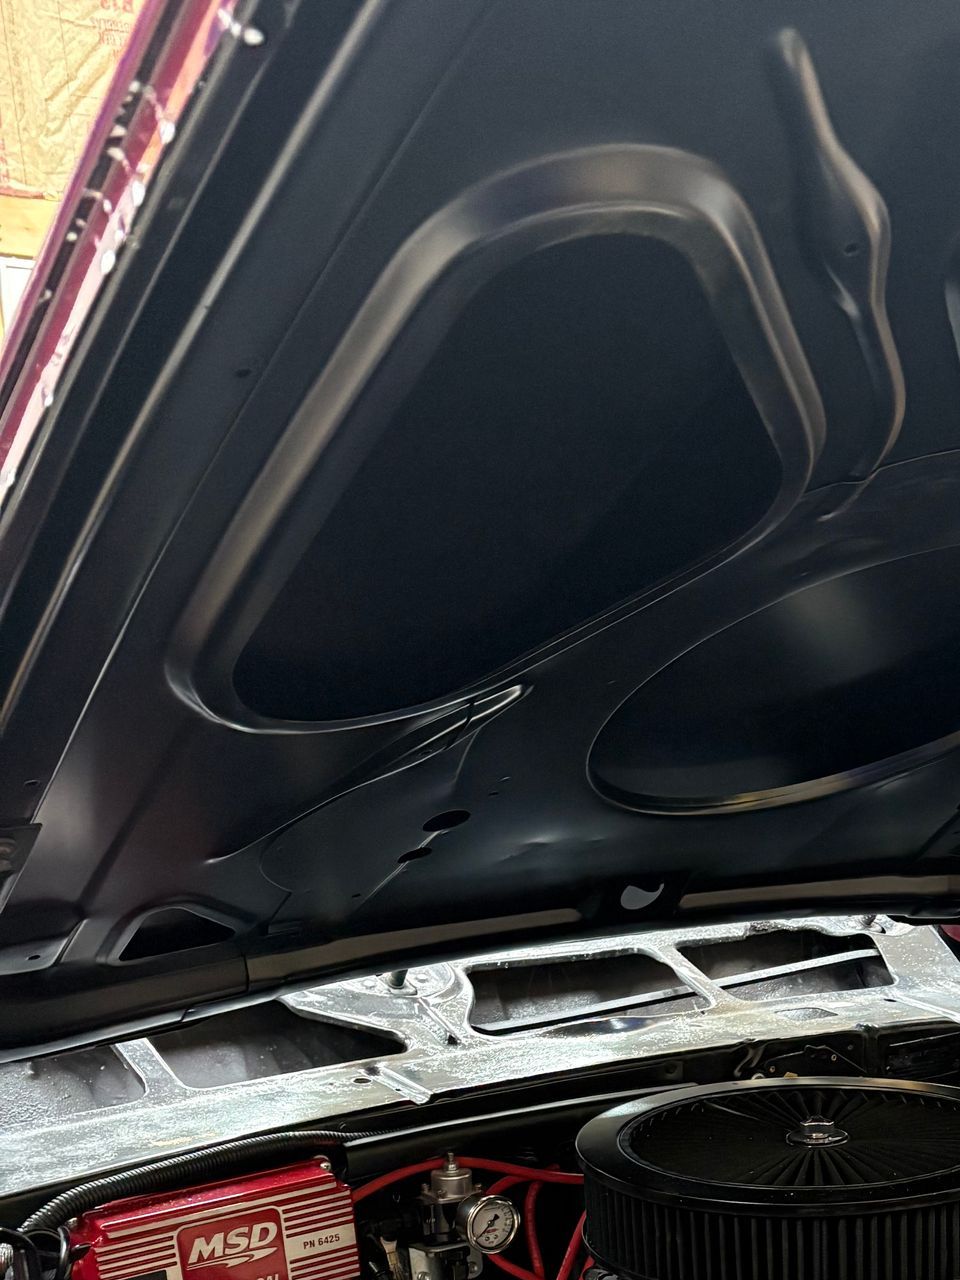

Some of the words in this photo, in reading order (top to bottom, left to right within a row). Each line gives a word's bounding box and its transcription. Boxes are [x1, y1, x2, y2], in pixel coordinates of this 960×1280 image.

[187, 1221, 278, 1265] MSD
[303, 1240, 316, 1250] PN
[318, 1234, 341, 1248] 6425
